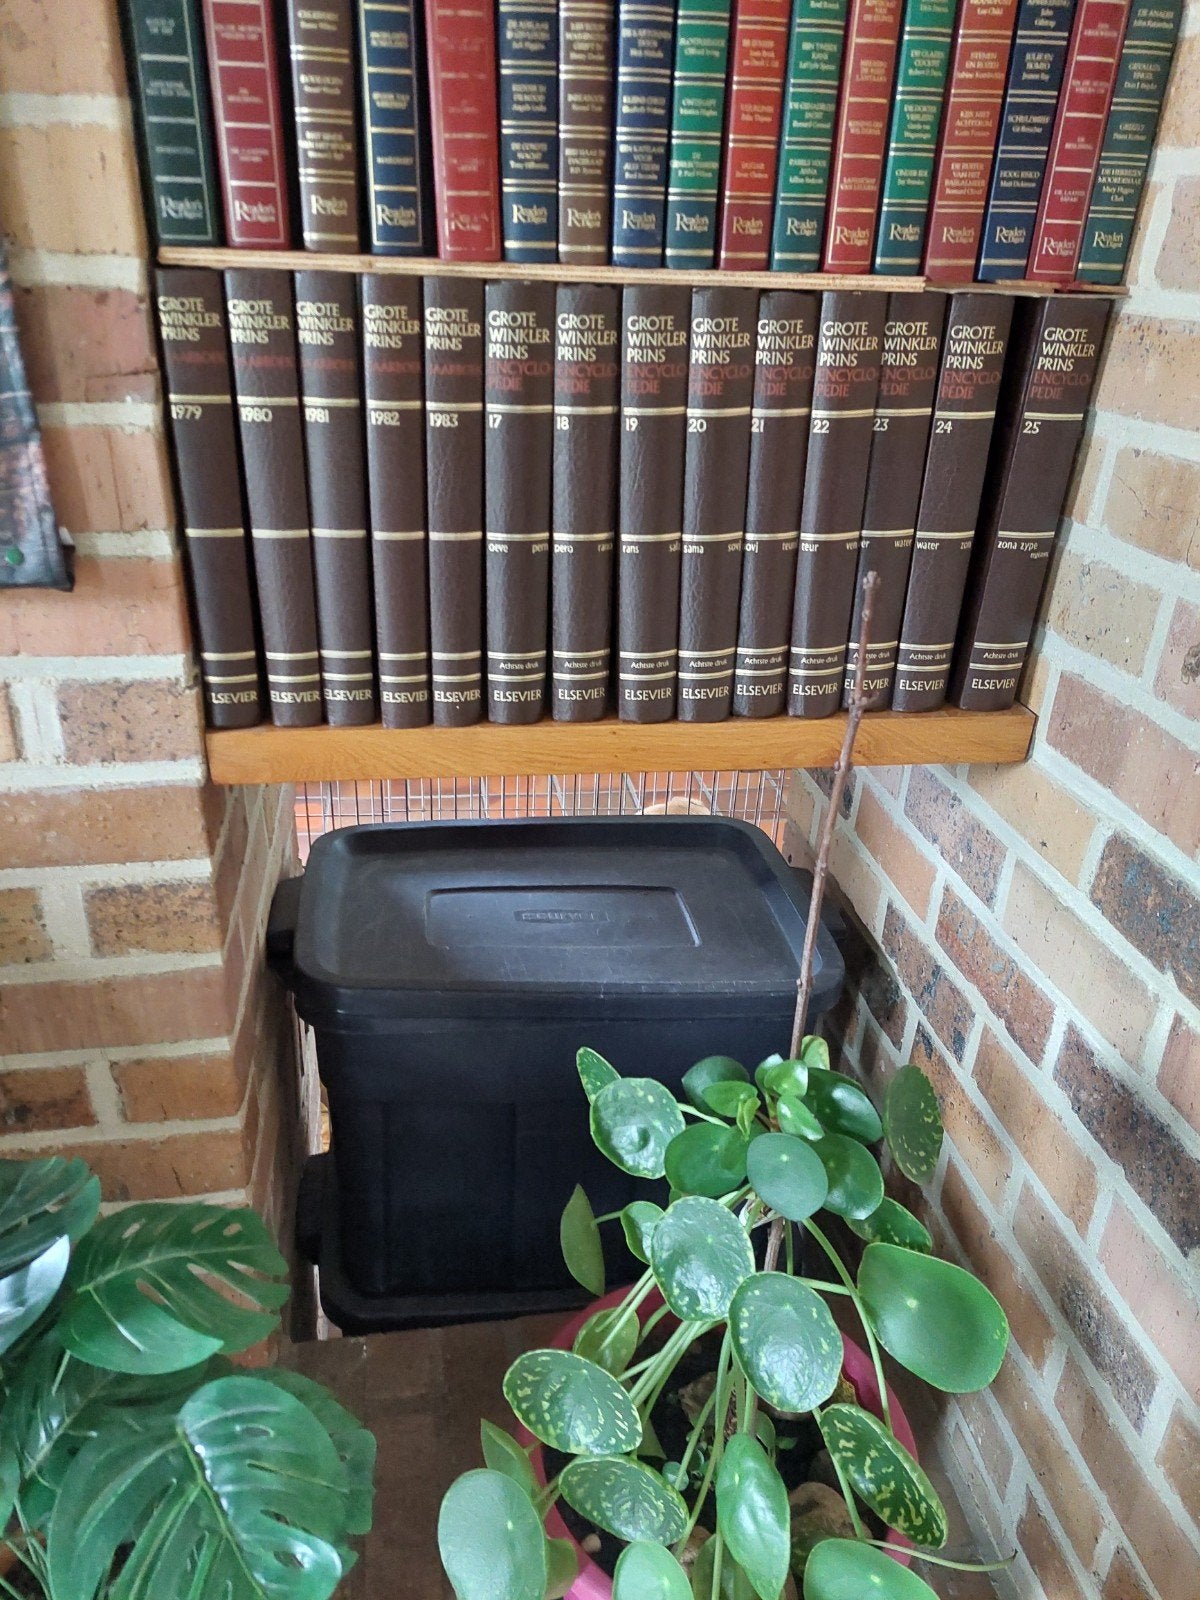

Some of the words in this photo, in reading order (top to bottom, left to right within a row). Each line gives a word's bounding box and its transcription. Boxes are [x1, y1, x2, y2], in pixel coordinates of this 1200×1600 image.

[158, 296, 204, 312] GROTE
[228, 299, 273, 315] GROTE
[296, 301, 340, 317] GROTE
[364, 304, 408, 319] GROTE
[425, 307, 469, 322] GROTE
[488, 310, 537, 327] GROTE
[160, 312, 222, 327] WINKLER
[229, 313, 290, 329] WINKLER
[297, 316, 354, 331] WINKLER
[364, 318, 420, 334] WINKLER
[558, 314, 605, 330] GROTE
[627, 315, 674, 331] GROTE
[692, 318, 738, 333] GROTE
[161, 326, 200, 341] PRINS
[426, 321, 480, 337] WINKLER
[758, 320, 803, 334] GROTE
[823, 321, 869, 336] GROTE
[885, 322, 929, 335] GROTE
[951, 326, 995, 339] GROTE
[230, 328, 269, 344] PRINS
[298, 330, 334, 346] PRINS
[365, 333, 402, 348] PRINS
[489, 327, 550, 344] WINKLER
[558, 330, 618, 346] WINKLER
[628, 331, 686, 347] WINKLER
[693, 333, 750, 348] WINKLER
[1044, 327, 1088, 342] GROTE
[426, 336, 462, 351] PRINS
[758, 335, 814, 350] WINKLER
[822, 337, 878, 351] WINKLER
[884, 336, 937, 350] WINKLER
[950, 341, 1003, 354] WINKLER
[1042, 342, 1095, 357] WINKLER
[489, 343, 528, 360] PRINS
[558, 346, 596, 361] PRINS
[627, 348, 665, 363] PRINS
[691, 349, 730, 364] PRINS
[756, 350, 793, 365] PRINS
[820, 353, 858, 366] PRINS
[881, 352, 918, 366] PRINS
[946, 355, 984, 369] PRINS
[1037, 357, 1074, 372] PRINS
[941, 386, 975, 400] PEDIE
[1030, 386, 1063, 399] PEDIE
[170, 404, 202, 420] 1979
[240, 406, 272, 422] 1980
[305, 407, 329, 423] 1981
[370, 410, 400, 426] 1982
[429, 413, 458, 427] 1983
[489, 414, 502, 428] 17
[556, 416, 569, 430] 18
[626, 417, 638, 431] 19
[688, 419, 706, 433] 20
[751, 418, 764, 432] 21
[813, 419, 830, 433] 22
[874, 419, 889, 431] 23
[936, 421, 952, 434] 24
[1023, 421, 1041, 434] 25
[554, 544, 574, 554] pero
[623, 544, 639, 554] rans
[684, 544, 704, 554] sama
[801, 542, 819, 552] teur
[895, 539, 912, 547] water
[916, 541, 940, 550] water
[961, 541, 972, 550] zon
[998, 541, 1017, 549] zona
[1020, 542, 1038, 551] zype
[736, 682, 782, 696] ELSEVIER
[793, 683, 838, 696] ELSEVIER
[844, 678, 889, 690] ELEVIER
[900, 679, 944, 691] ELSEVIER
[972, 678, 1015, 689] ELSEVIER
[210, 690, 258, 704] LSEVIER
[270, 690, 320, 703] ELSEVIER
[324, 688, 373, 701] ELSEVIER
[434, 689, 480, 702] ELSEVIER
[494, 689, 542, 702] ELSEVIER
[559, 687, 605, 700] ELSEVIER
[625, 687, 672, 701] ELSEVIER
[682, 686, 729, 699] ELSEVIER
